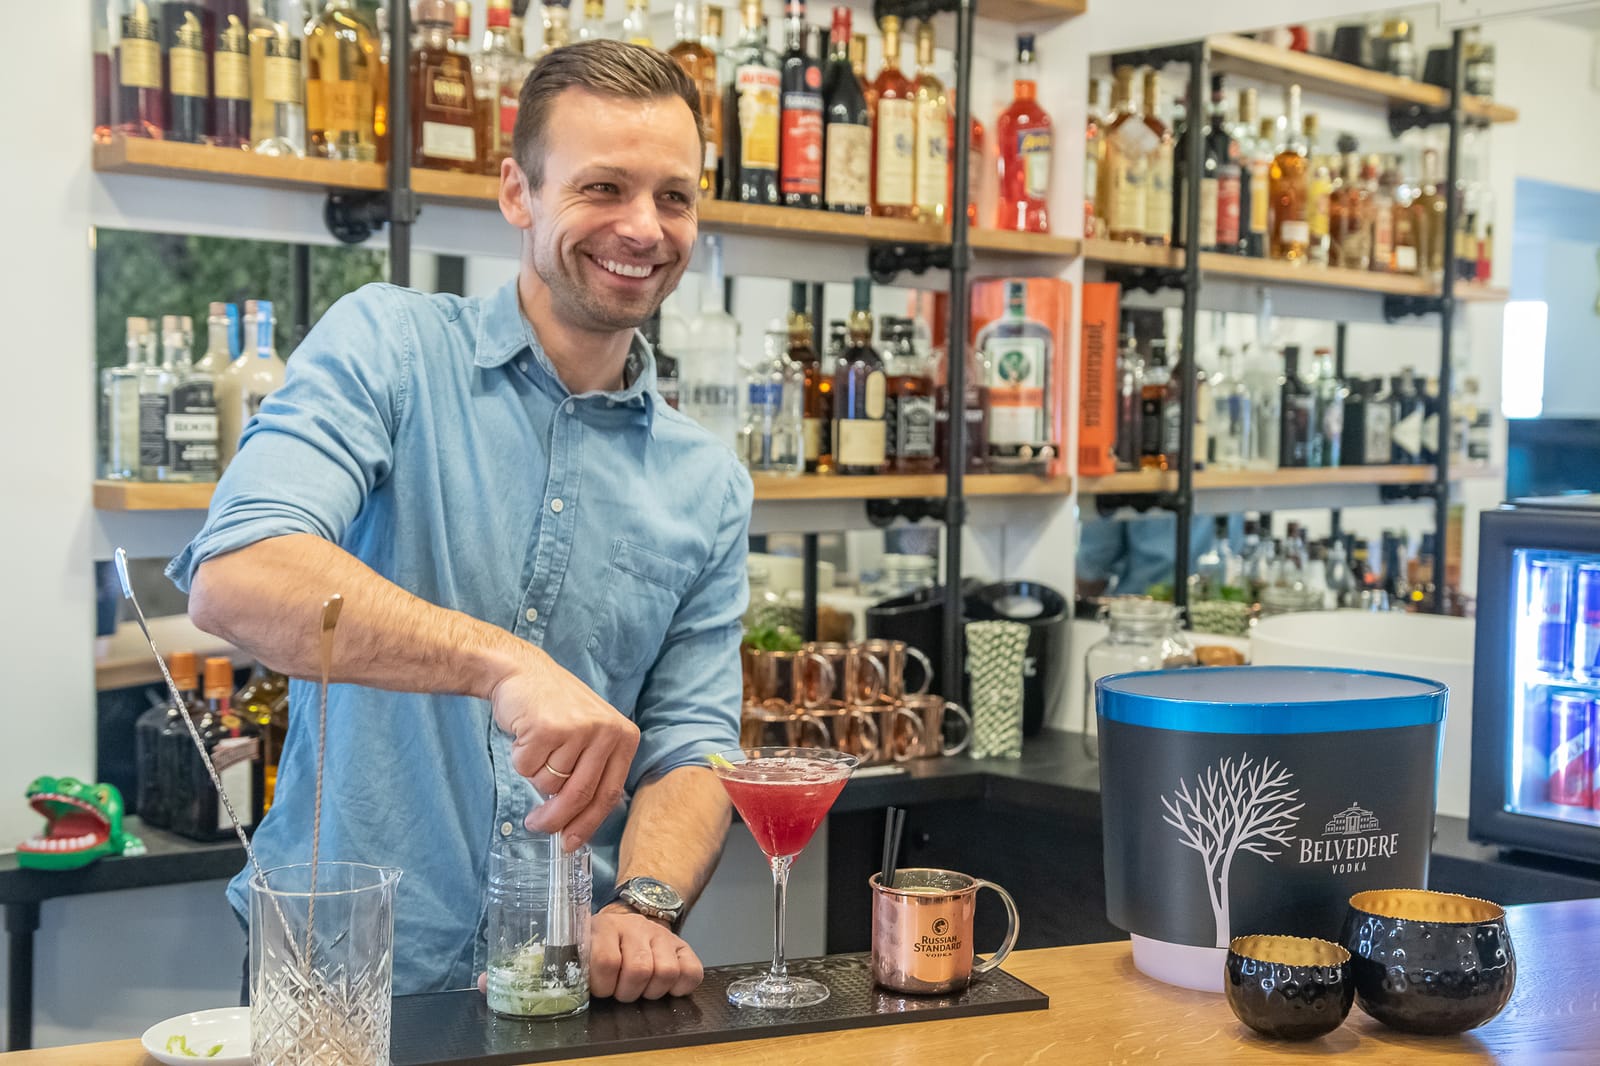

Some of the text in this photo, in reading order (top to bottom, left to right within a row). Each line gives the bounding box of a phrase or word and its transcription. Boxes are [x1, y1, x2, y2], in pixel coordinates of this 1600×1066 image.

[1299, 833, 1399, 864] BELVEDERE
[1332, 862, 1367, 875] VODKA
[921, 935, 957, 945] RUSSIAN
[913, 941, 961, 953] STANDARD
